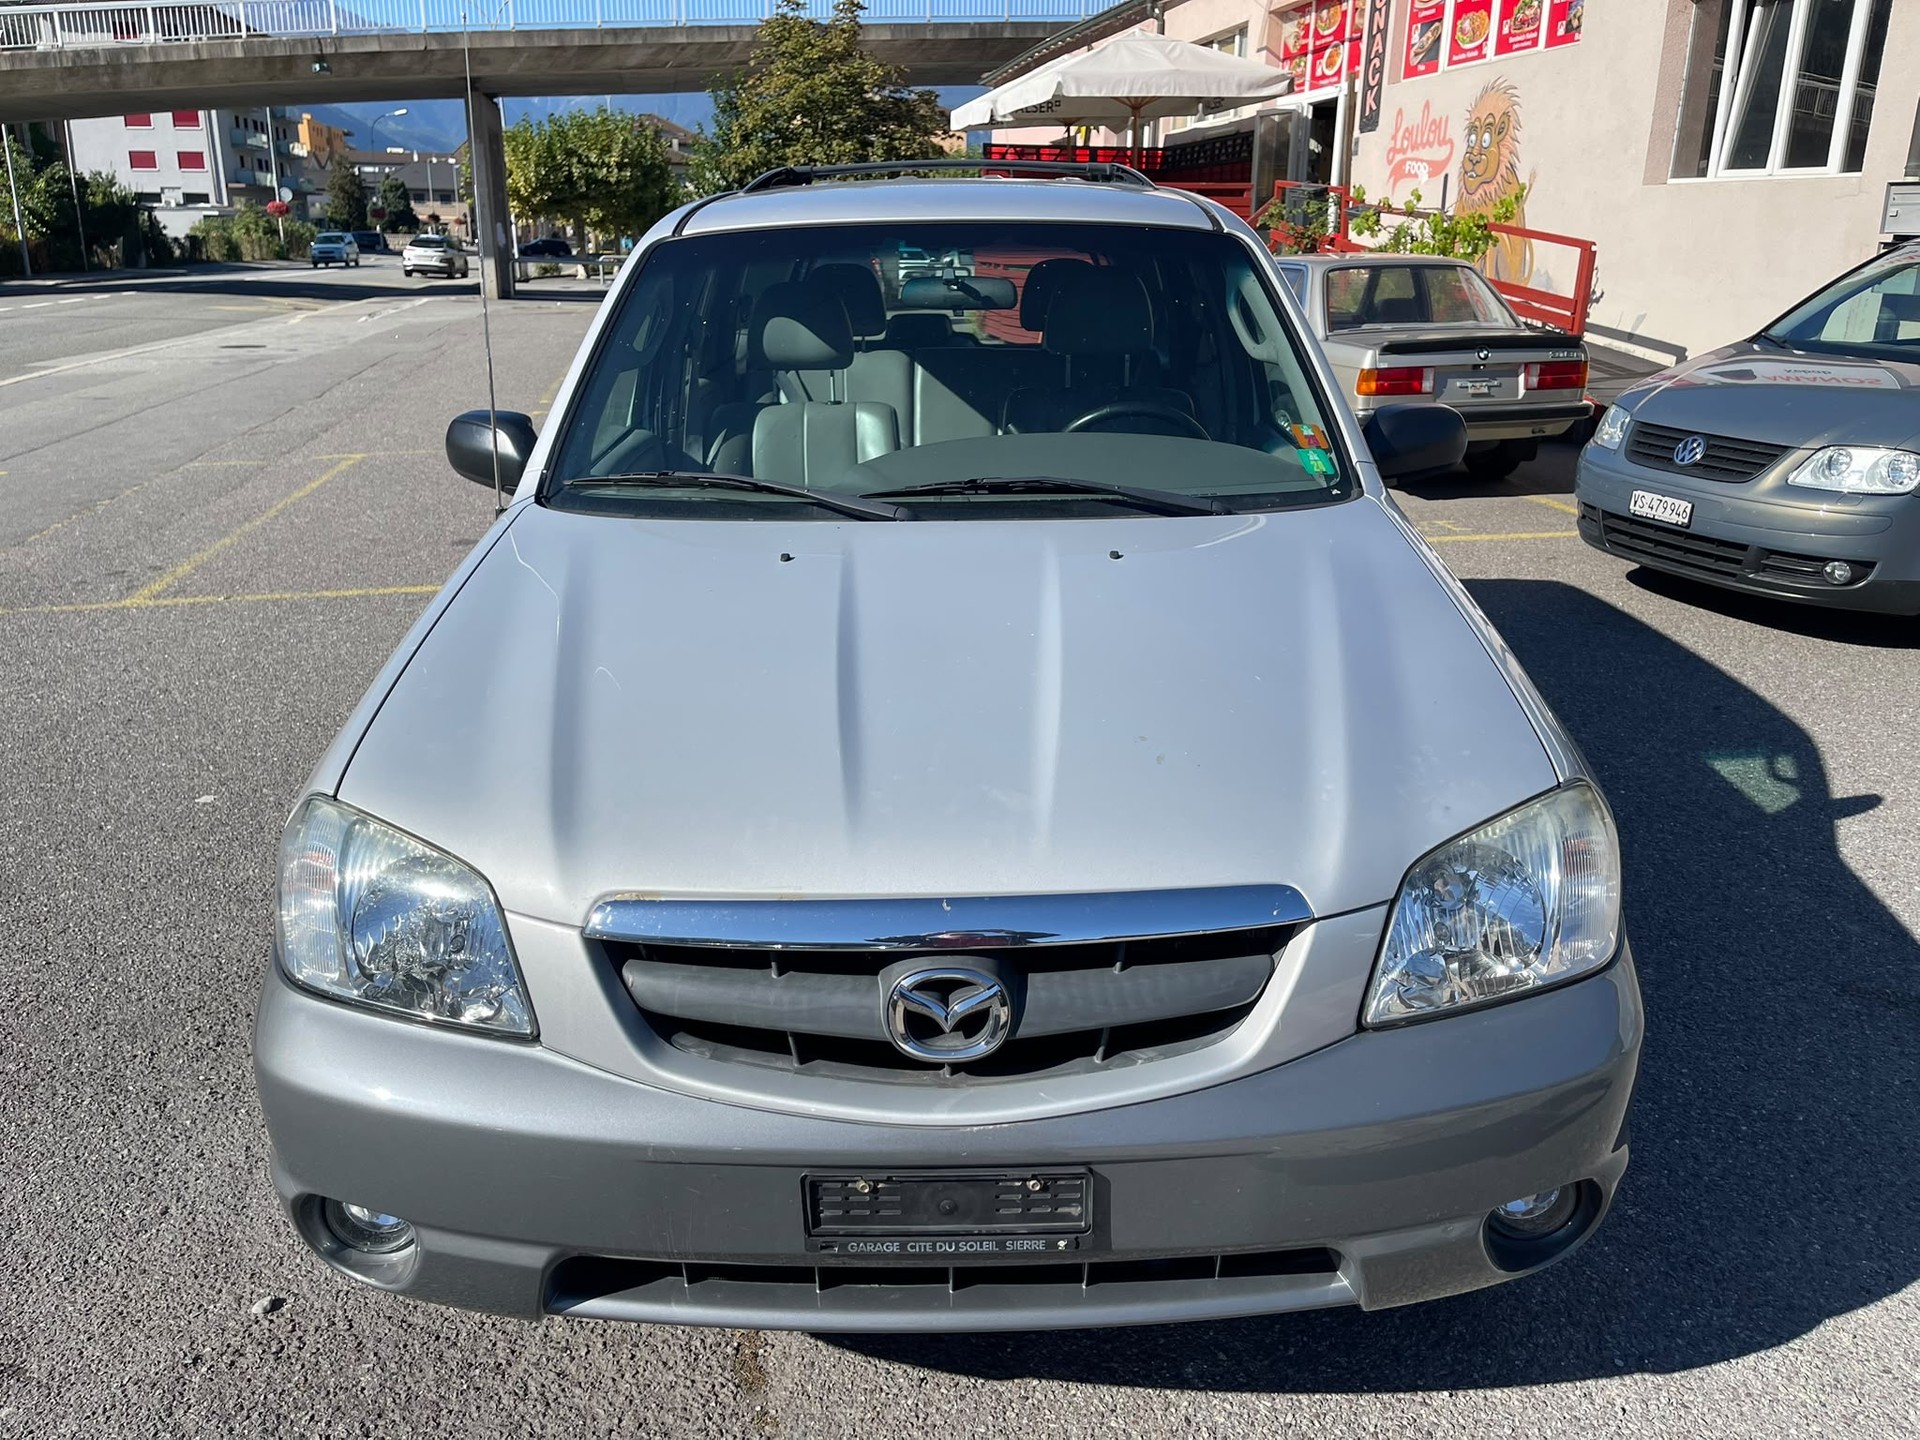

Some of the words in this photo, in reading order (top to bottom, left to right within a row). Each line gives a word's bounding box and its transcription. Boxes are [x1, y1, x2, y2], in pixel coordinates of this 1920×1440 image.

[1386, 98, 1451, 166] Loulou
[1405, 160, 1429, 174] FOOD
[847, 1241, 900, 1253] GARAGE
[907, 1241, 933, 1252] CITE
[936, 1241, 956, 1252] DU
[958, 1240, 999, 1252] SOLEIL
[1005, 1239, 1046, 1251] SIERRE
